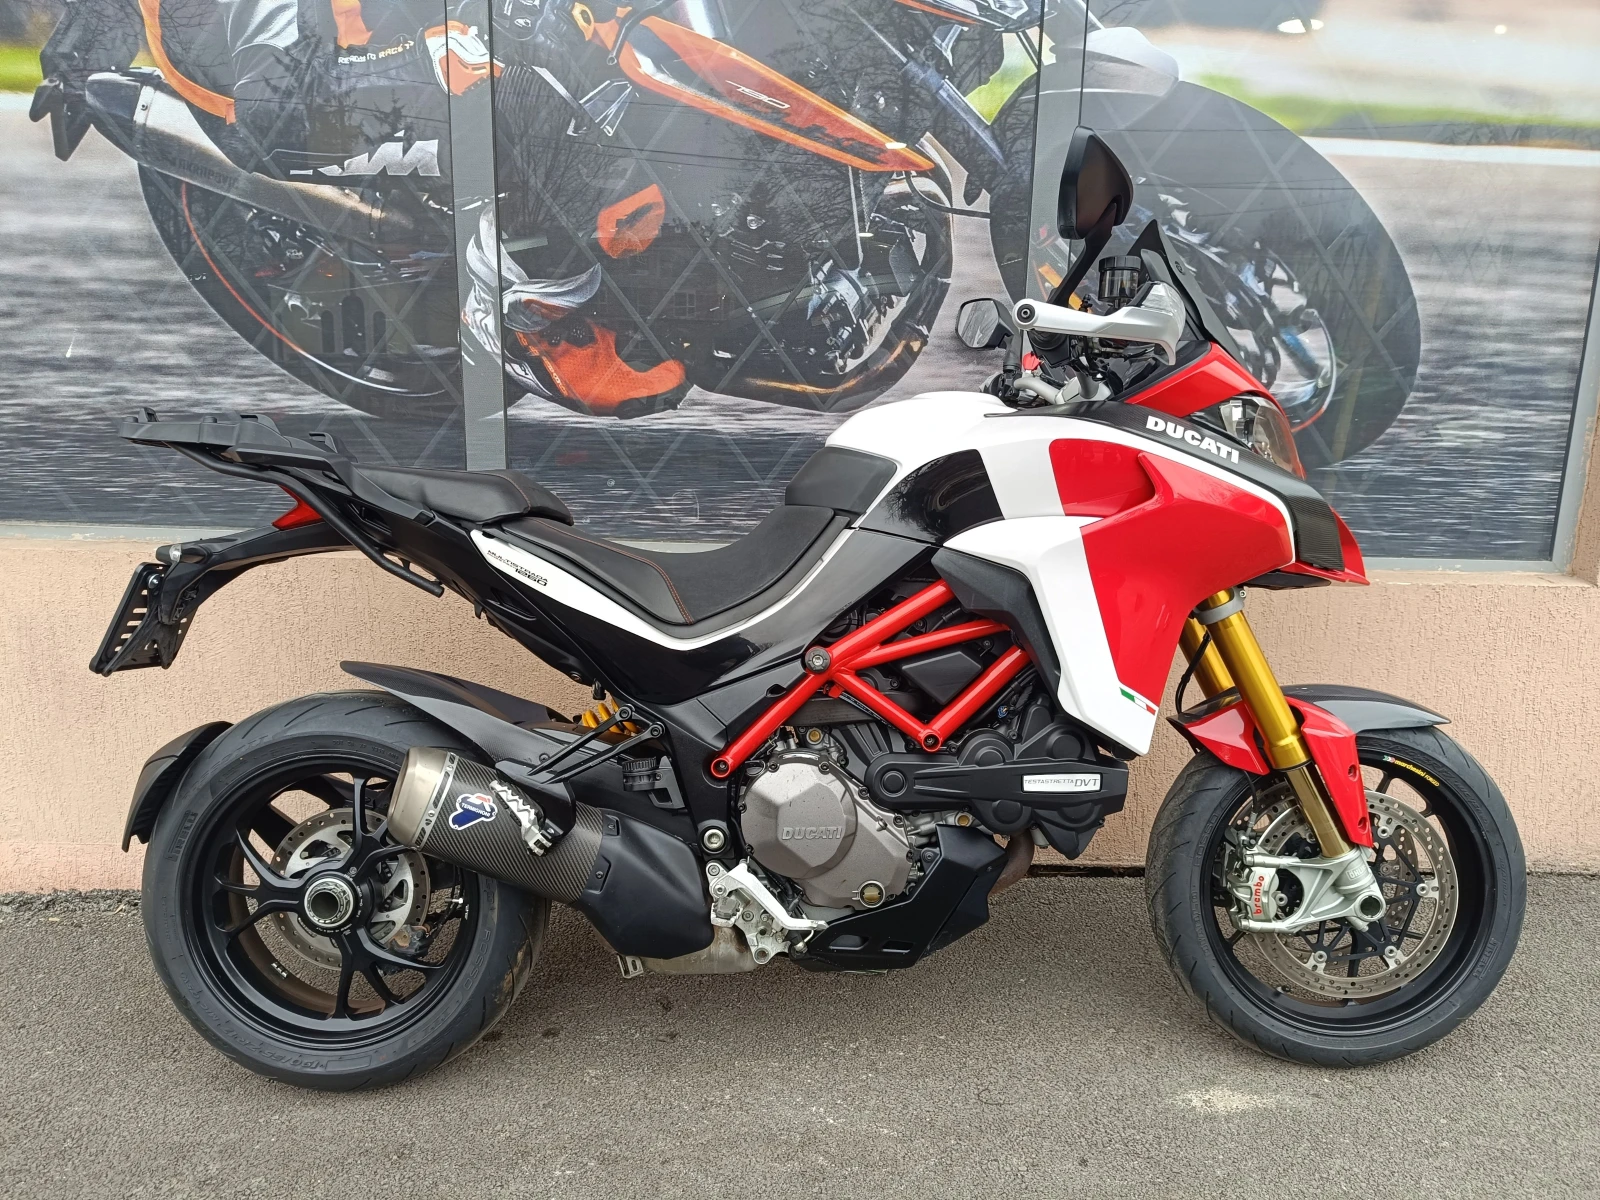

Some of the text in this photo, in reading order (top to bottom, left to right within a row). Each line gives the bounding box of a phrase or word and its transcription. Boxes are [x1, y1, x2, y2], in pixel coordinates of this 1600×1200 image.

[1146, 415, 1239, 464] DUCATI
[1074, 778, 1100, 787] DVT
[461, 802, 491, 817] TERMIGNONI
[782, 826, 843, 840] DUCATI
[1253, 875, 1265, 915] brembo
[463, 929, 492, 990] ROSSO
